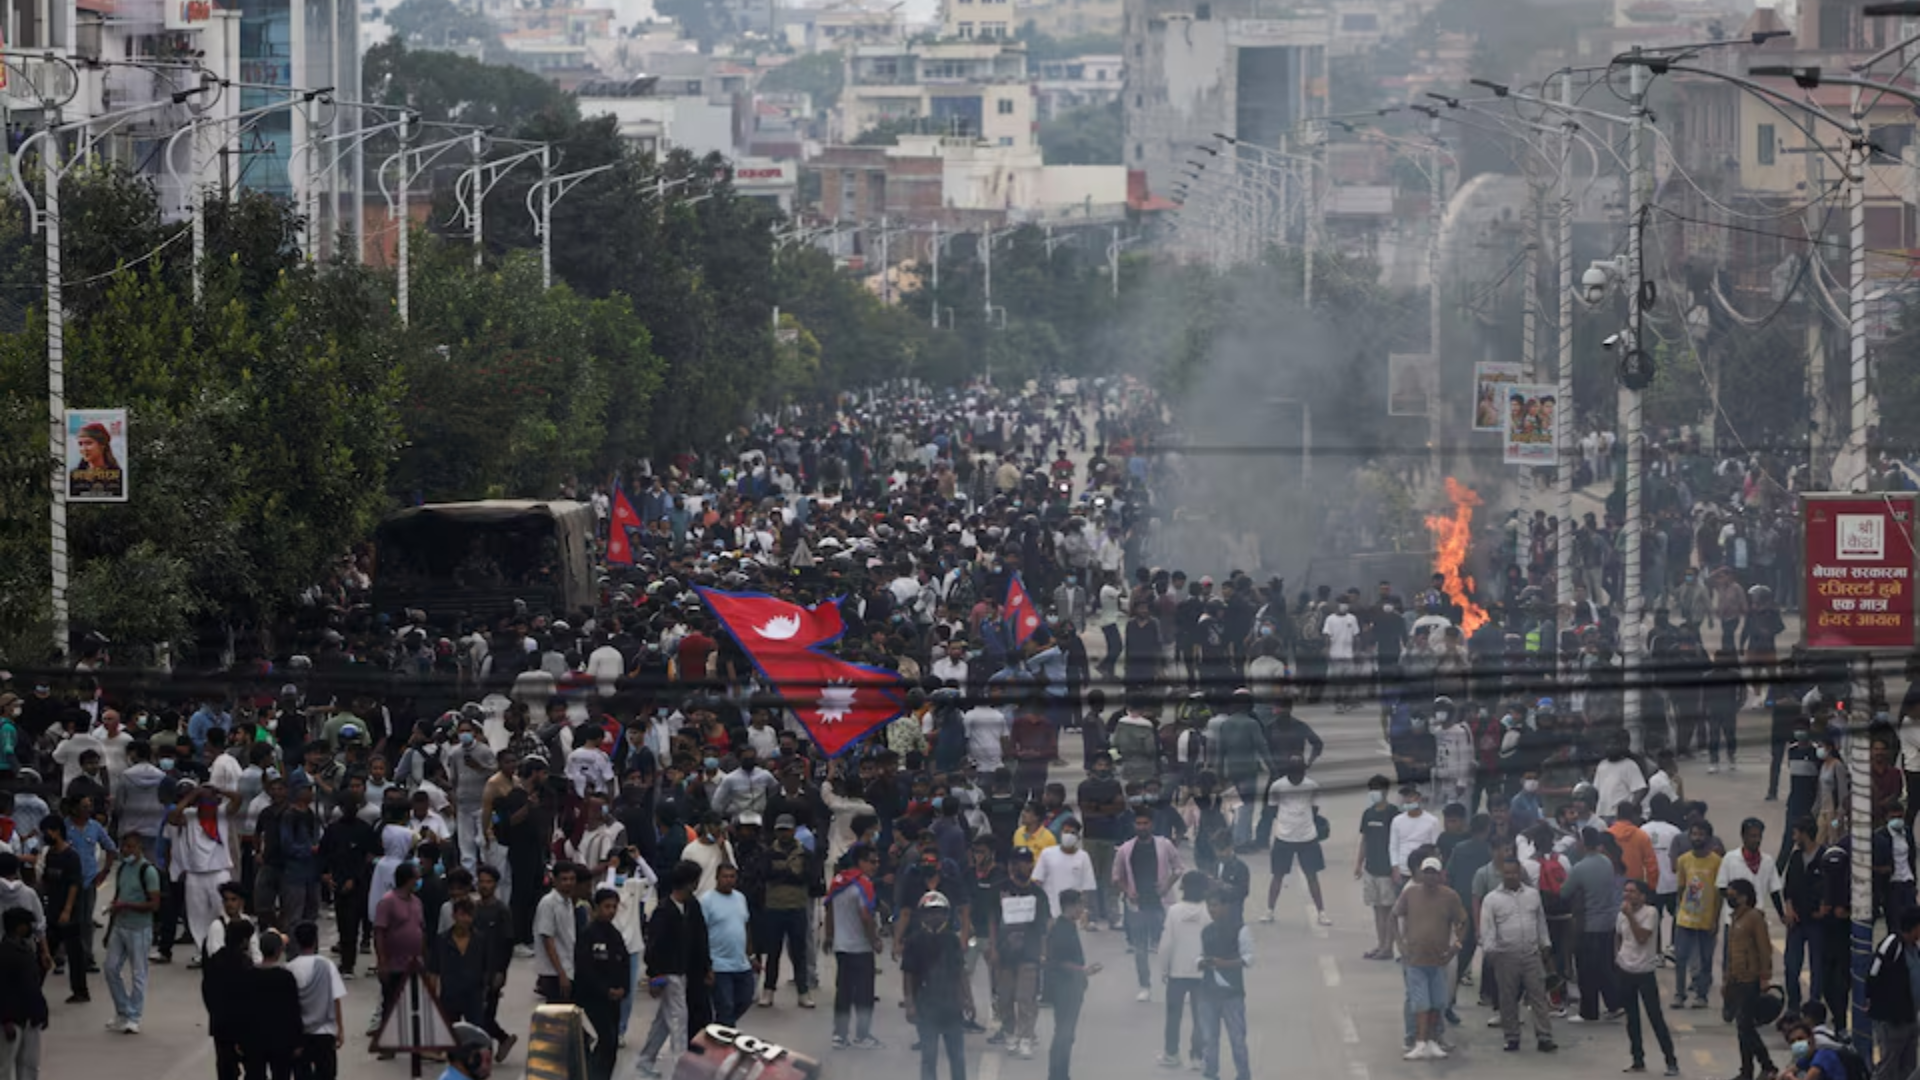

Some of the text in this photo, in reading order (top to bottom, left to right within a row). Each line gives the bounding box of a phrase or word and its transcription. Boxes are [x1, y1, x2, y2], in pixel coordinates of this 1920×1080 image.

[1859, 519, 1874, 534] श्री
[1812, 564, 1908, 578] नेपाल सरकारमा
[1818, 579, 1902, 598] रजिस्टर्ड हुने
[1832, 599, 1888, 611] एक मात्र
[1818, 610, 1901, 626] हेयर आयल
